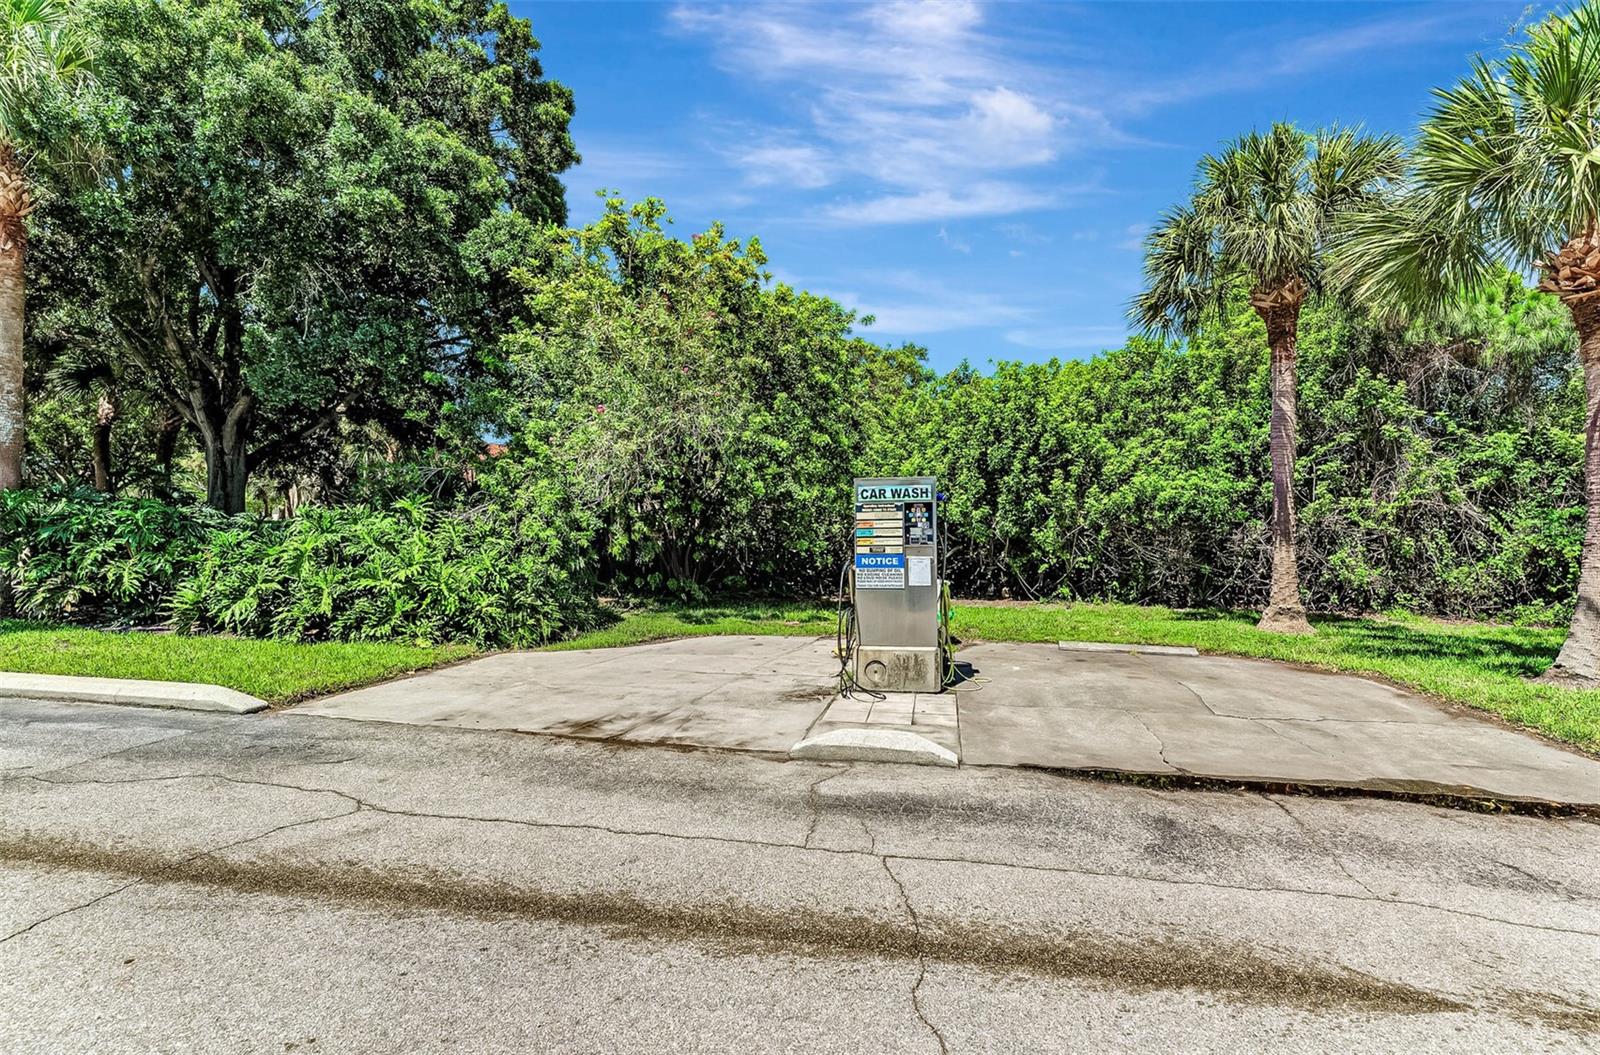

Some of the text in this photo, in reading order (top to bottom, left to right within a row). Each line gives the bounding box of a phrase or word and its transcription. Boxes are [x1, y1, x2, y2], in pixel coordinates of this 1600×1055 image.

[860, 487, 929, 500] CAR WASH
[861, 557, 899, 565] NOTICE
